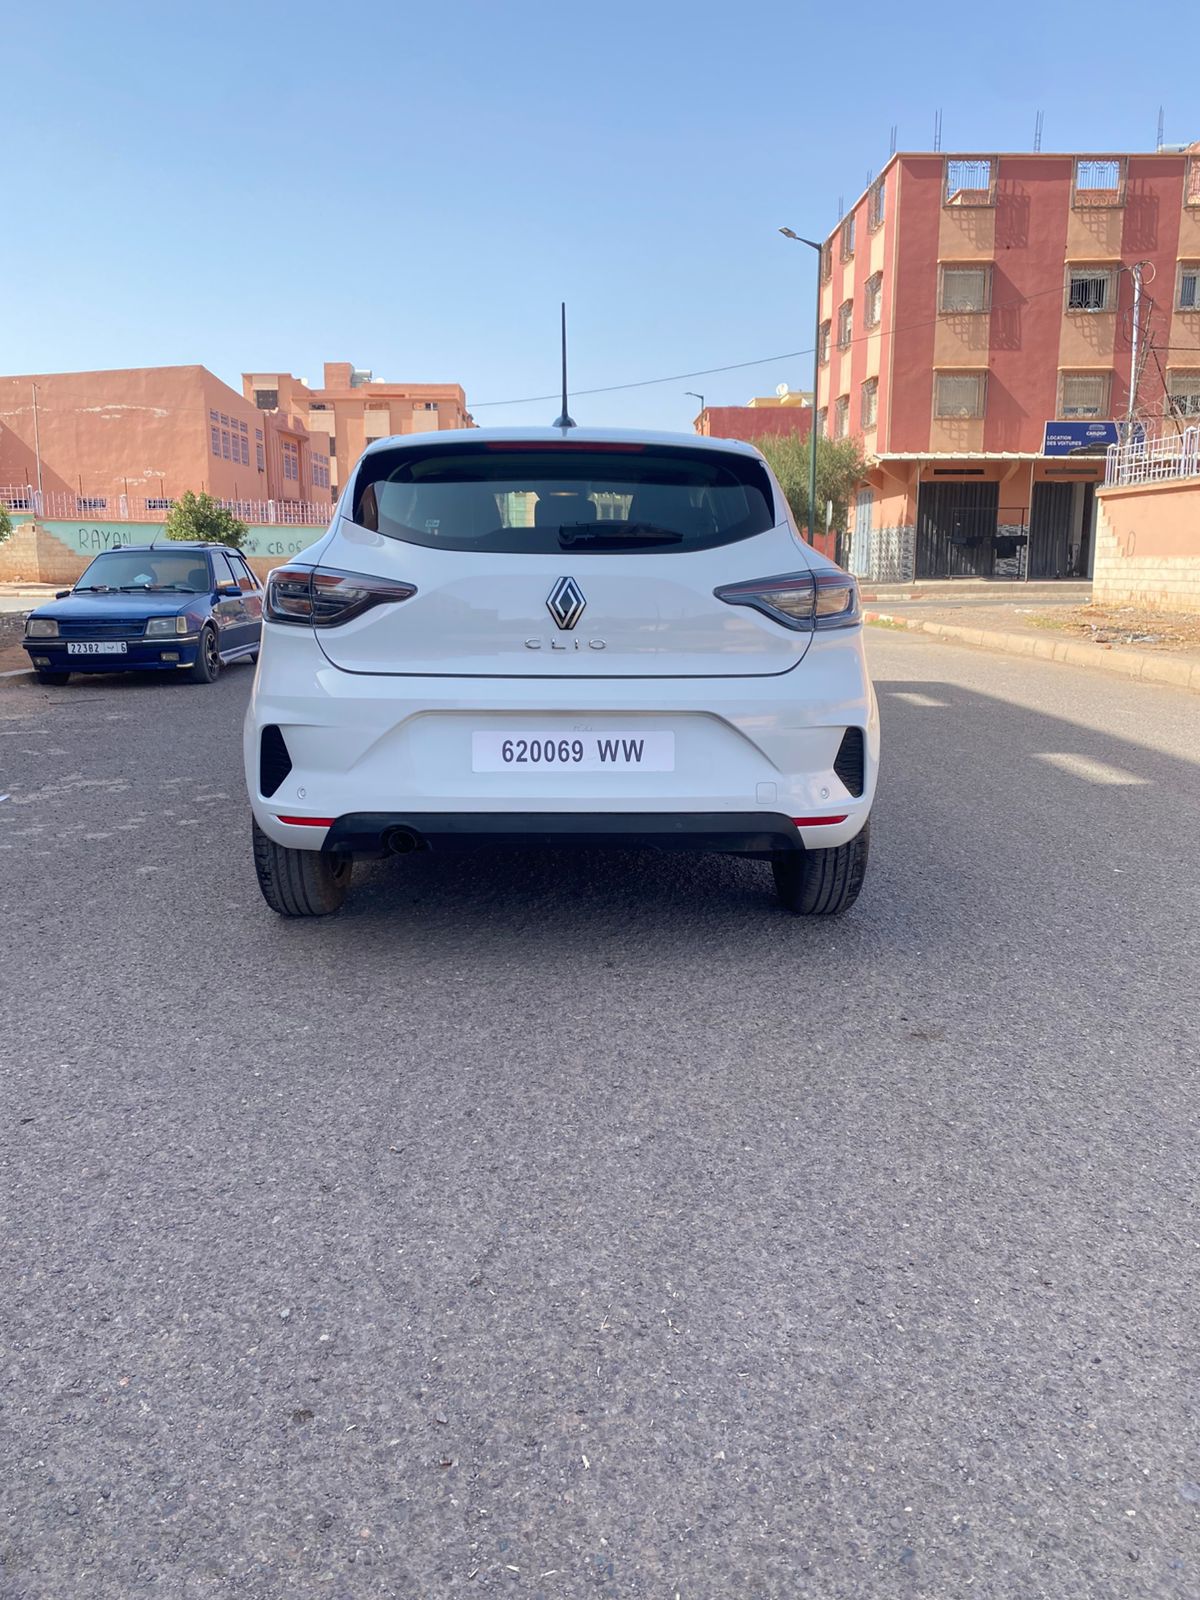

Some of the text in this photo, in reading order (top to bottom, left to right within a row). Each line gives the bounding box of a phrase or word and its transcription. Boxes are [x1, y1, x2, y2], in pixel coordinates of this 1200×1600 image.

[78, 528, 132, 550] RAYAN
[71, 643, 100, 653] 22382
[120, 643, 128, 653] 6
[524, 638, 607, 650] CLIO
[501, 739, 645, 763] 620069 WW
